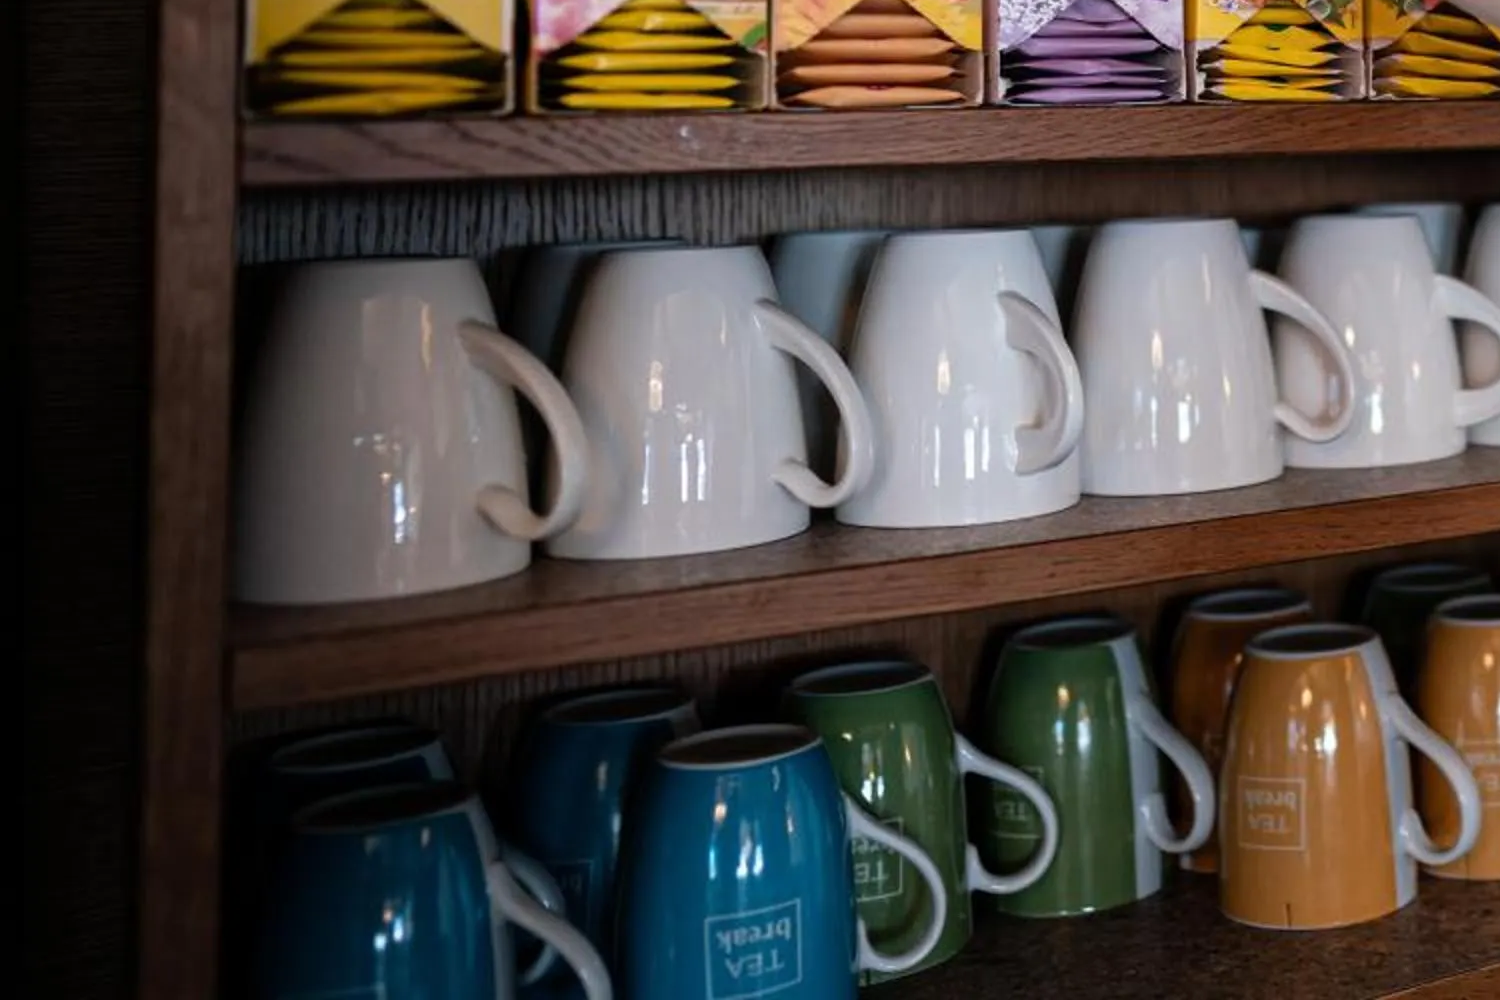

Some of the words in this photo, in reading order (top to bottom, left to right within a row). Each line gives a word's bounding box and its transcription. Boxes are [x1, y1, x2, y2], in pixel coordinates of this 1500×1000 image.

[1248, 812, 1291, 834] TEA
[716, 916, 792, 956] break
[724, 948, 785, 979] TEA
